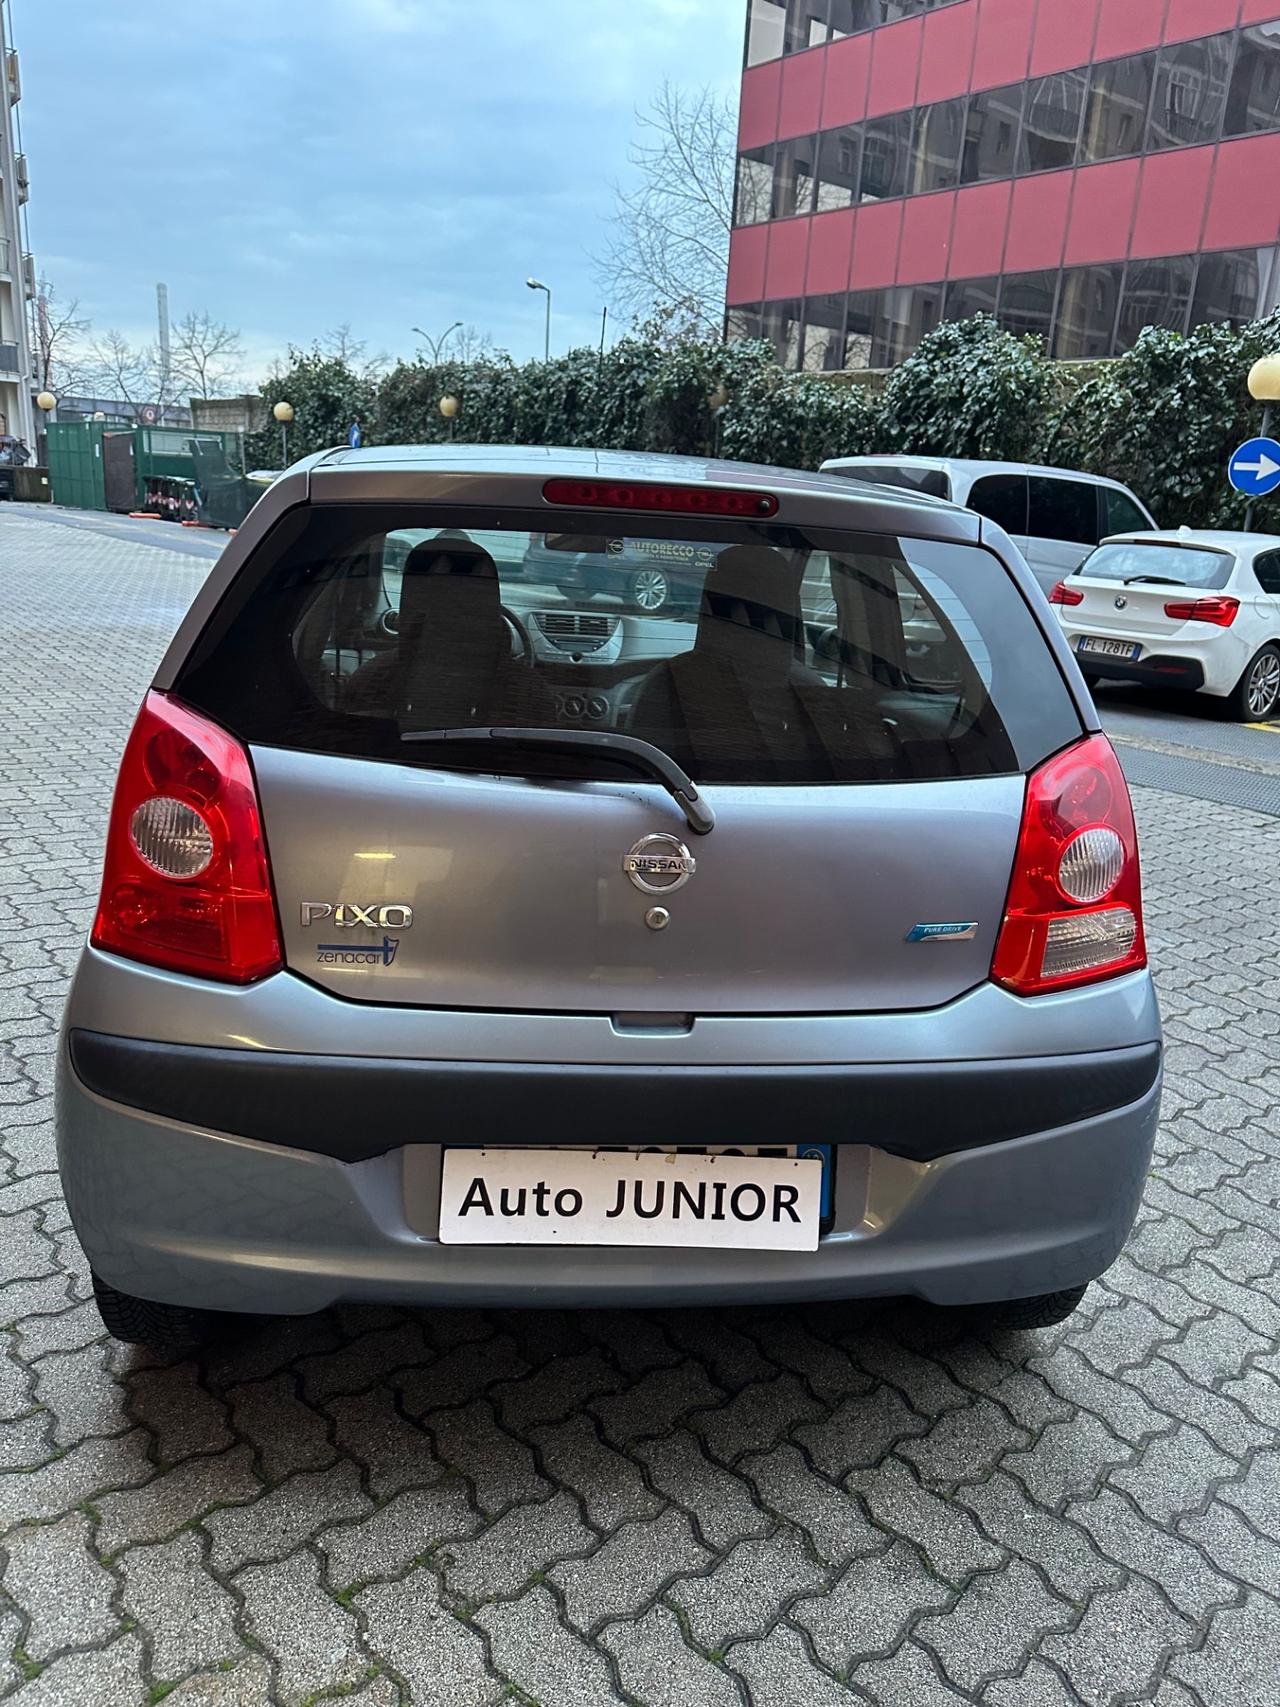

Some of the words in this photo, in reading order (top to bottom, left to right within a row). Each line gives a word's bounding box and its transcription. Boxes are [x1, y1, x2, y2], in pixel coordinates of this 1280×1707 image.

[631, 541, 694, 557] AUTORECCO
[1085, 638, 1097, 651] FL
[1102, 641, 1134, 656] 128TF
[630, 858, 687, 870] NISSAN
[316, 951, 382, 965] zenacar
[457, 1177, 584, 1218] Auto
[606, 1179, 802, 1224] JUNIOR
